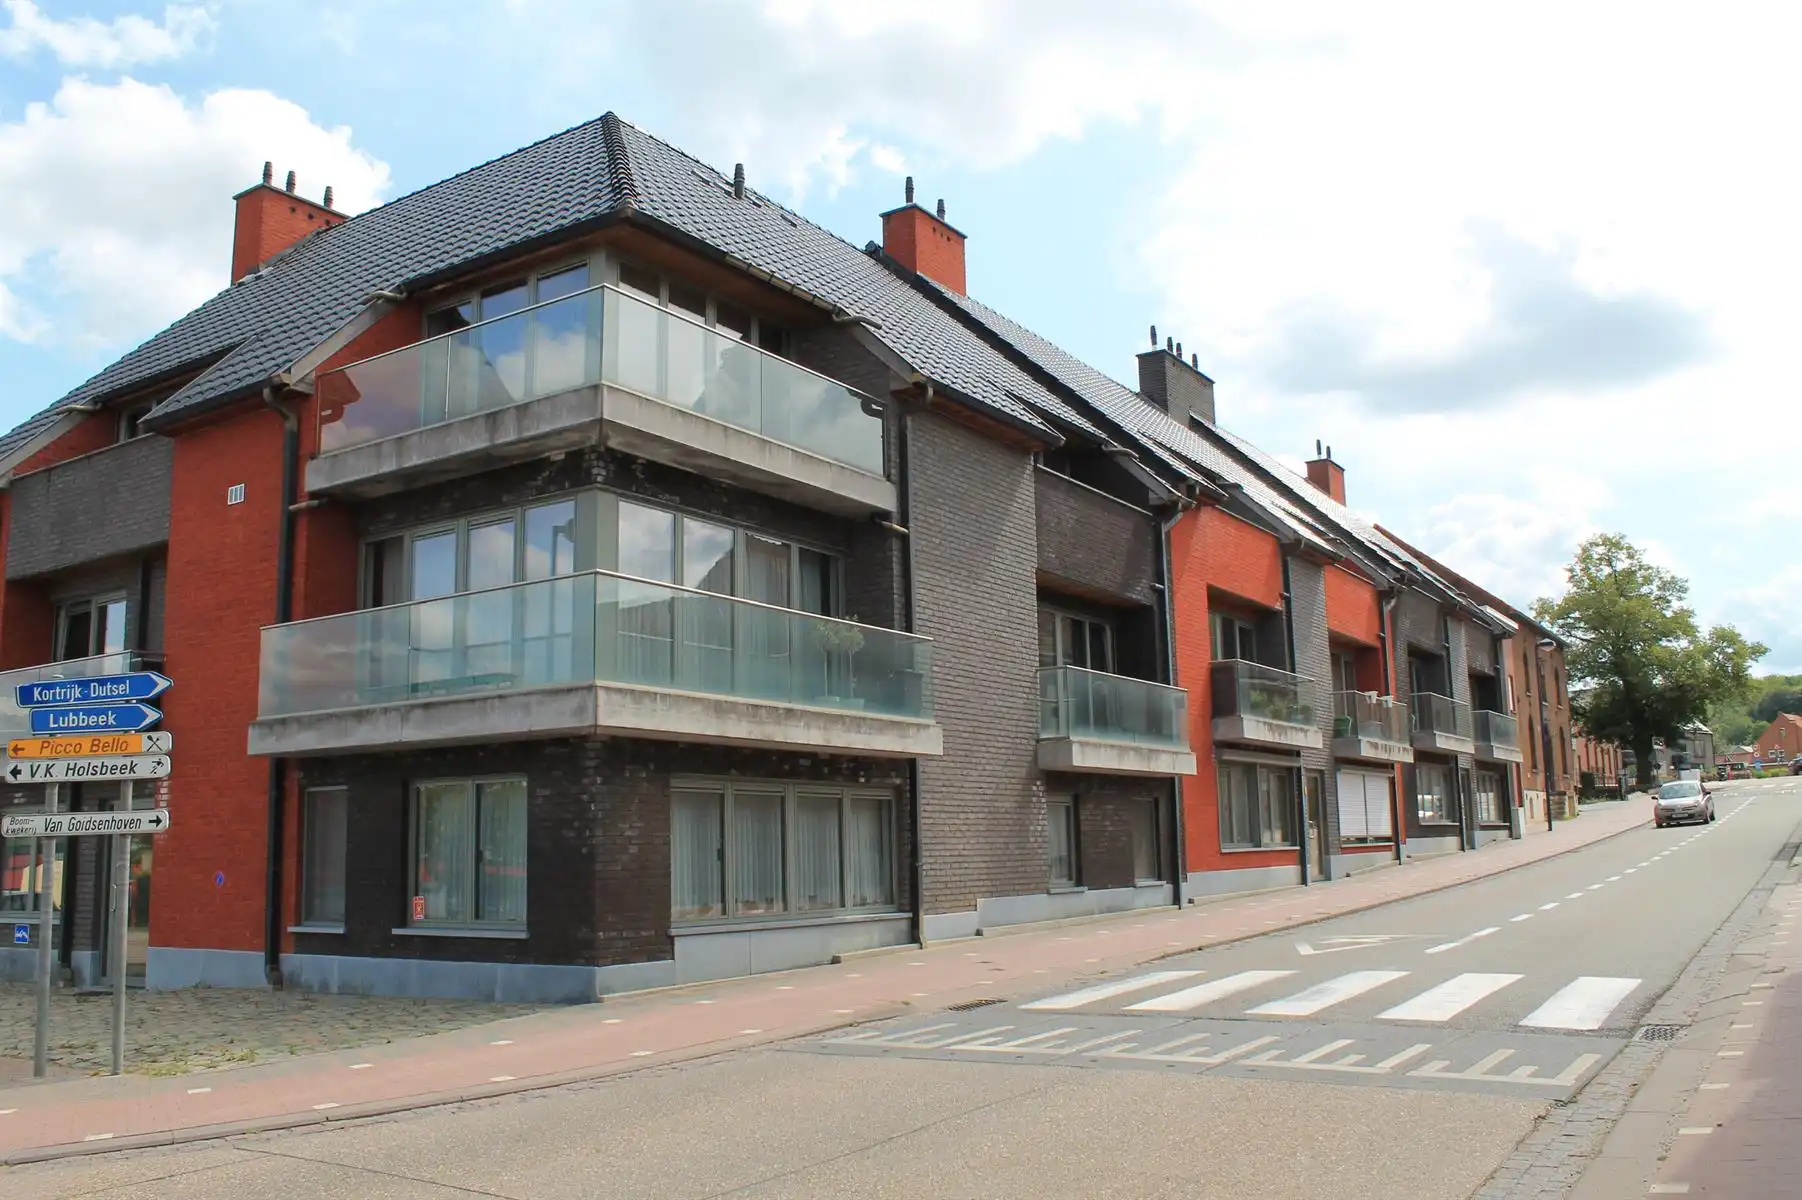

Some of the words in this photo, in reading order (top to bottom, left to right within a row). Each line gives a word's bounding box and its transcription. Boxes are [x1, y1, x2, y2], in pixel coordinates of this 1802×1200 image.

[50, 711, 116, 728] Lubbeek
[40, 740, 82, 755] Picco
[89, 738, 128, 753] Bello
[65, 761, 138, 777] Holsbeek
[10, 817, 35, 826] Boom-
[44, 818, 62, 833] Van
[68, 816, 141, 832] Goidsenhoven
